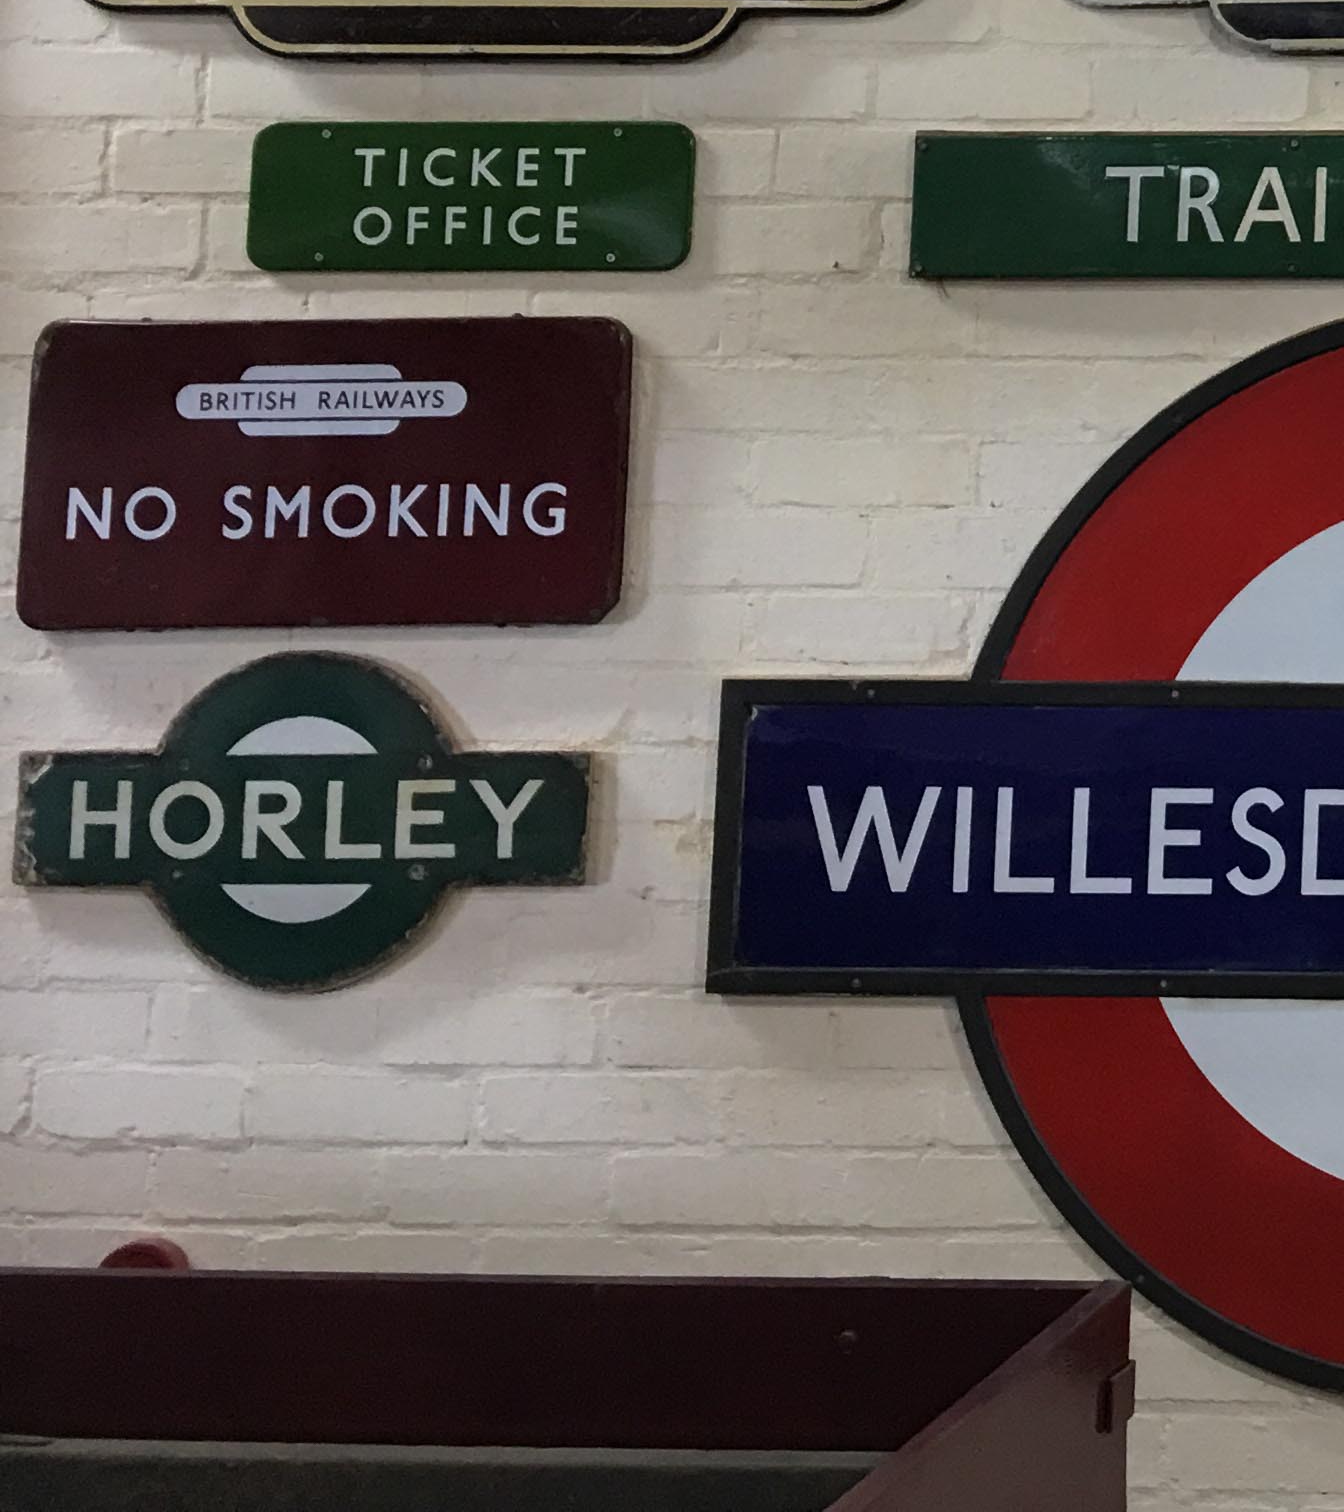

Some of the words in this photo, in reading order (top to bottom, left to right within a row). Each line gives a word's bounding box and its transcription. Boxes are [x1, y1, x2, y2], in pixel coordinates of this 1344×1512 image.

[355, 148, 586, 186] TICKET
[354, 206, 578, 245] OFFICE
[200, 391, 296, 411] BRITISH
[319, 390, 444, 409] RAILWAYS
[66, 487, 176, 540] NO
[223, 483, 566, 539] SMOKING
[70, 780, 544, 859] HORLEY
